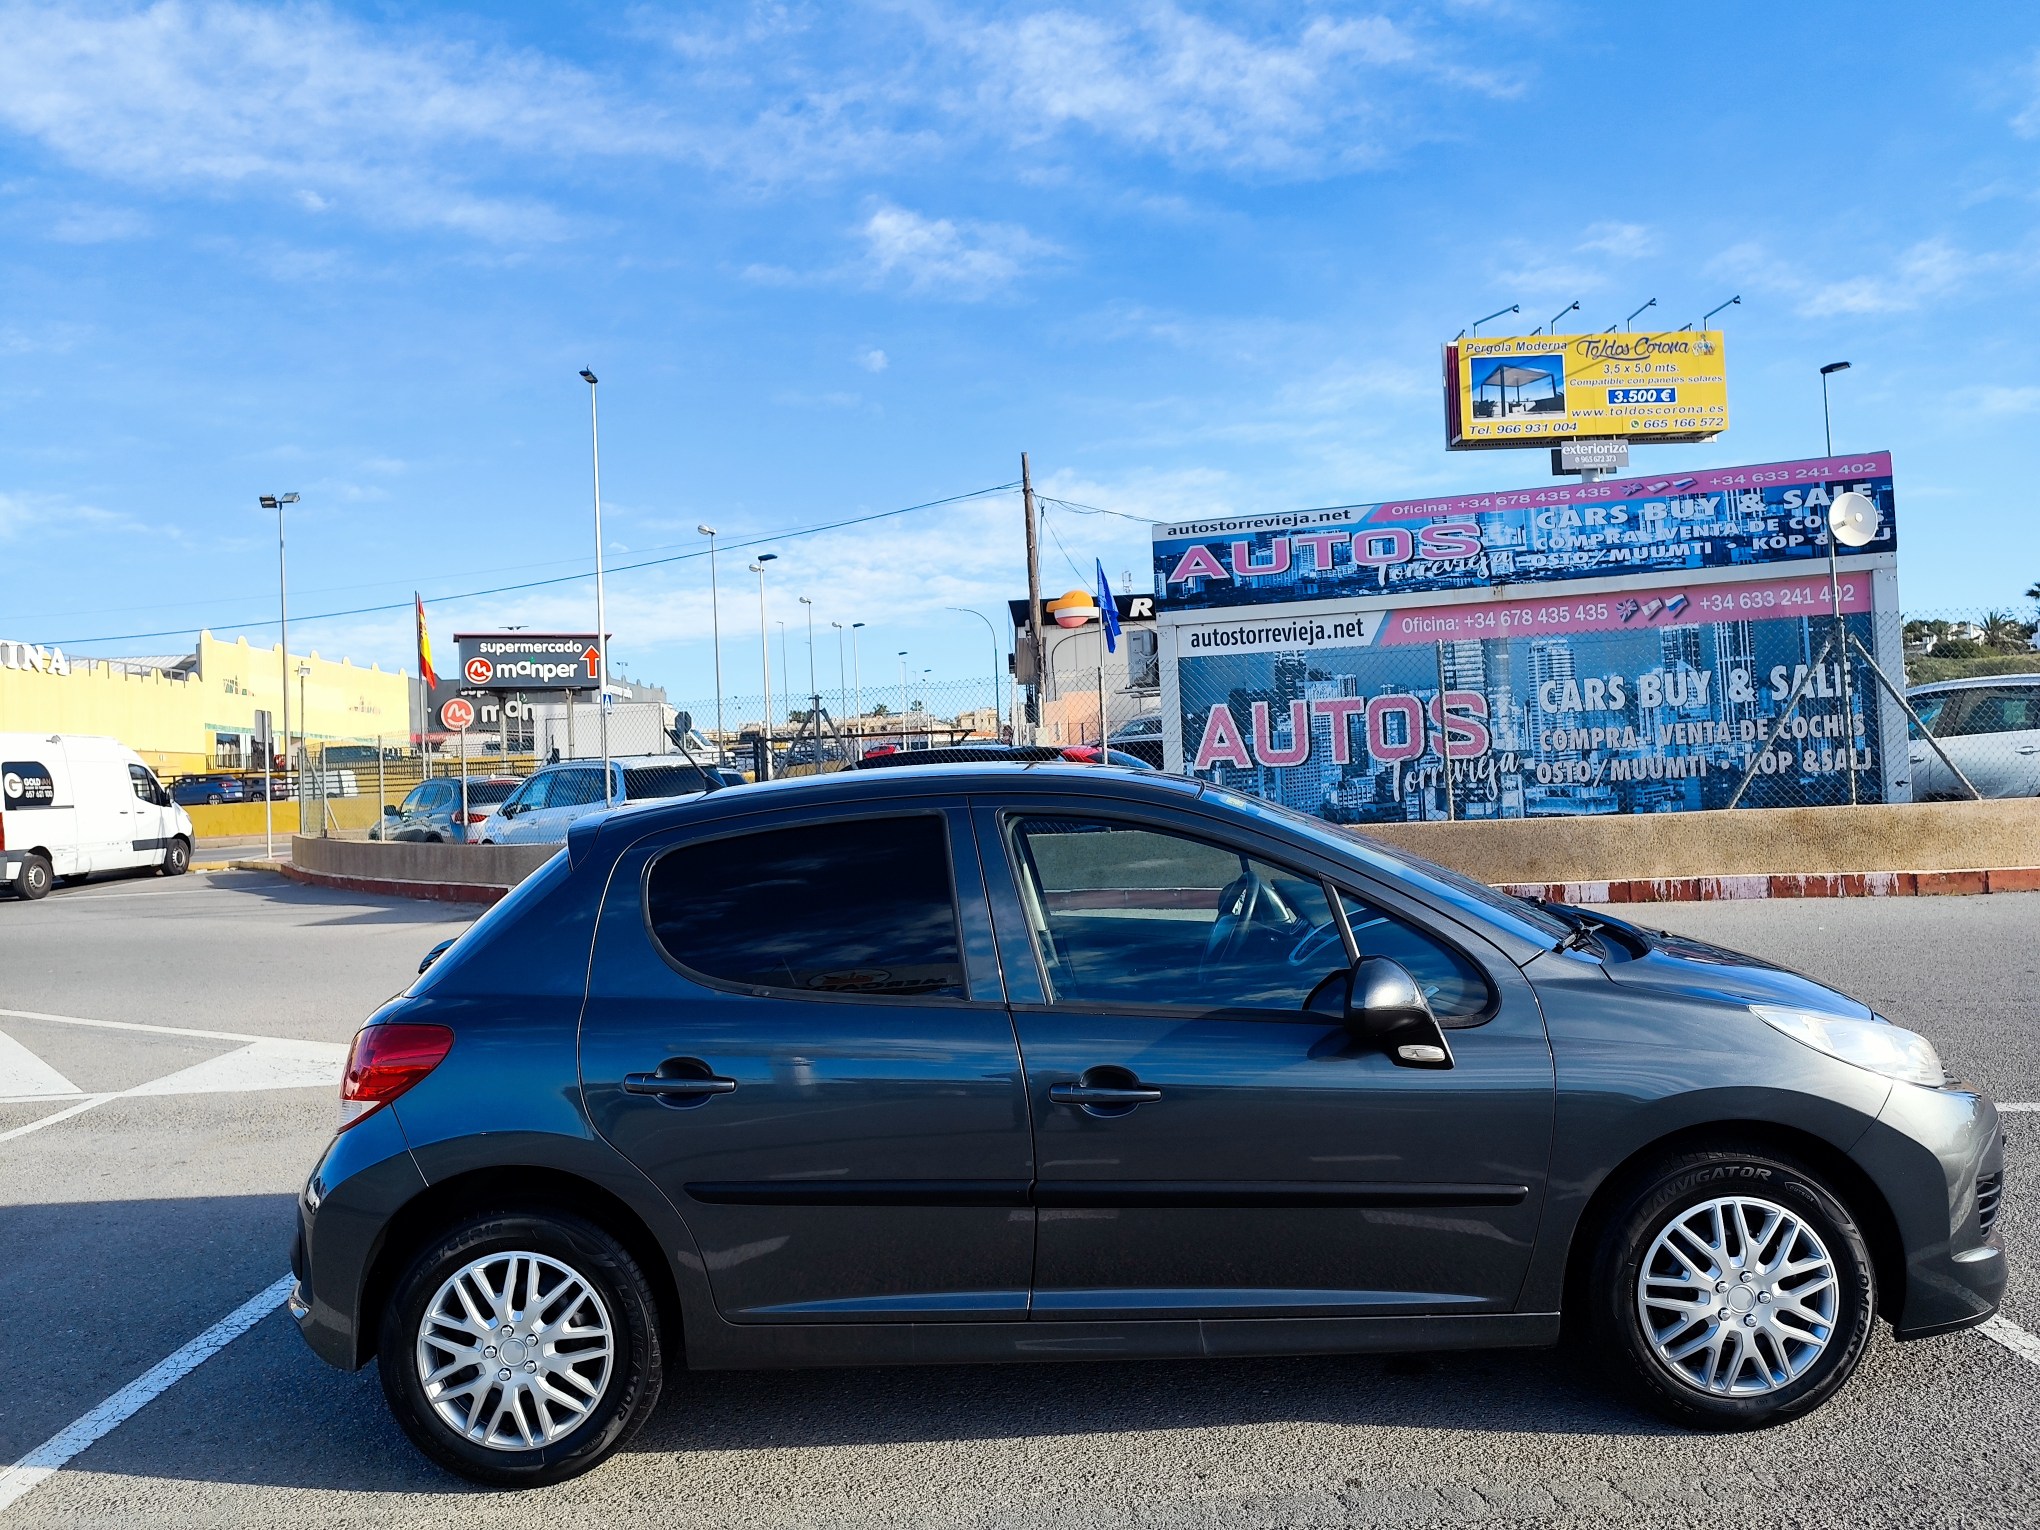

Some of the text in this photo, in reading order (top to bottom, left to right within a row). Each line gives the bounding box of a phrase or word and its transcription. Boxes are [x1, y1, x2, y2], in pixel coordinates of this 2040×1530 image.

[1516, 342, 1567, 351] Moderna
[1634, 337, 1689, 357] Corona
[1604, 363, 1621, 374] 3,5
[1635, 363, 1651, 373] 5,0
[1655, 364, 1680, 372] mts.
[1570, 378, 1624, 387] Compatible
[1648, 376, 1685, 385] paneles
[1614, 389, 1672, 403] 3.500 €
[1571, 405, 1725, 417] www.toldoscorona.es
[1470, 422, 1577, 435] Tel. 966 931 004
[1644, 418, 1724, 428] 665 166 572
[1562, 443, 1628, 455] exterioriza
[1709, 463, 1877, 486] +34 633 241 402
[1391, 487, 1611, 516] Oficina: +34 678 435 435
[1536, 505, 1629, 530] CARS
[1643, 496, 1721, 521] BUY
[1739, 493, 1767, 513] &
[1167, 509, 1351, 536] autostorrevieja.net
[1536, 530, 1640, 550] COMPRA
[1661, 522, 1740, 540] VENTA
[1749, 518, 1780, 533] DE
[1752, 533, 1805, 550] KÖP
[1166, 523, 1484, 584] AUTOS
[1376, 549, 1515, 587] Torrevieja
[1700, 594, 1735, 611] +34
[1739, 590, 1775, 609] 633
[1779, 587, 1815, 606] 241
[1402, 603, 1609, 634] Oficina: +34 678 435 435
[1190, 617, 1365, 649] autostorrevieja.net
[480, 640, 582, 656] supermercado
[496, 660, 578, 682] manper
[1539, 675, 1627, 713] CARS
[1639, 670, 1712, 708] BUY
[1728, 668, 1757, 703] &
[1194, 690, 1490, 771] AUTOS
[1540, 713, 1865, 752] COMPRA VENTA DE COCHS
[1385, 749, 1520, 802] Torrevieja
